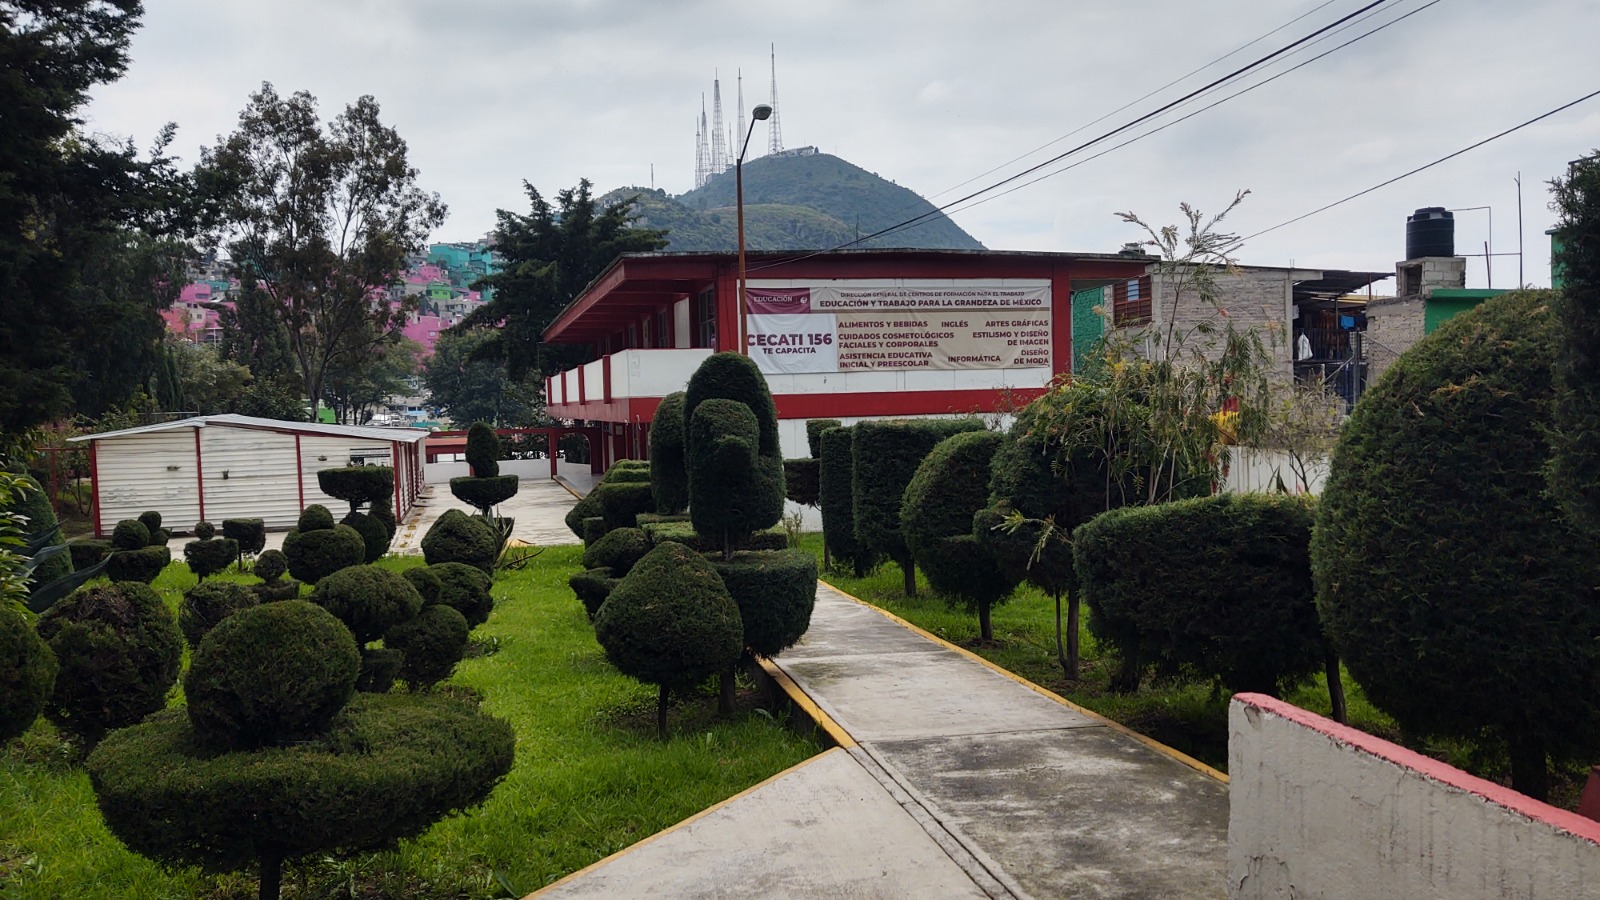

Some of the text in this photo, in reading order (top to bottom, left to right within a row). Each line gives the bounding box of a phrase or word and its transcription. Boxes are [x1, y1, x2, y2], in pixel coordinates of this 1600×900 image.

[820, 299, 868, 307] EDUCACIÓN
[882, 331, 954, 339] COSMETOLÓGICOS
[747, 333, 832, 346] CECATI 156
